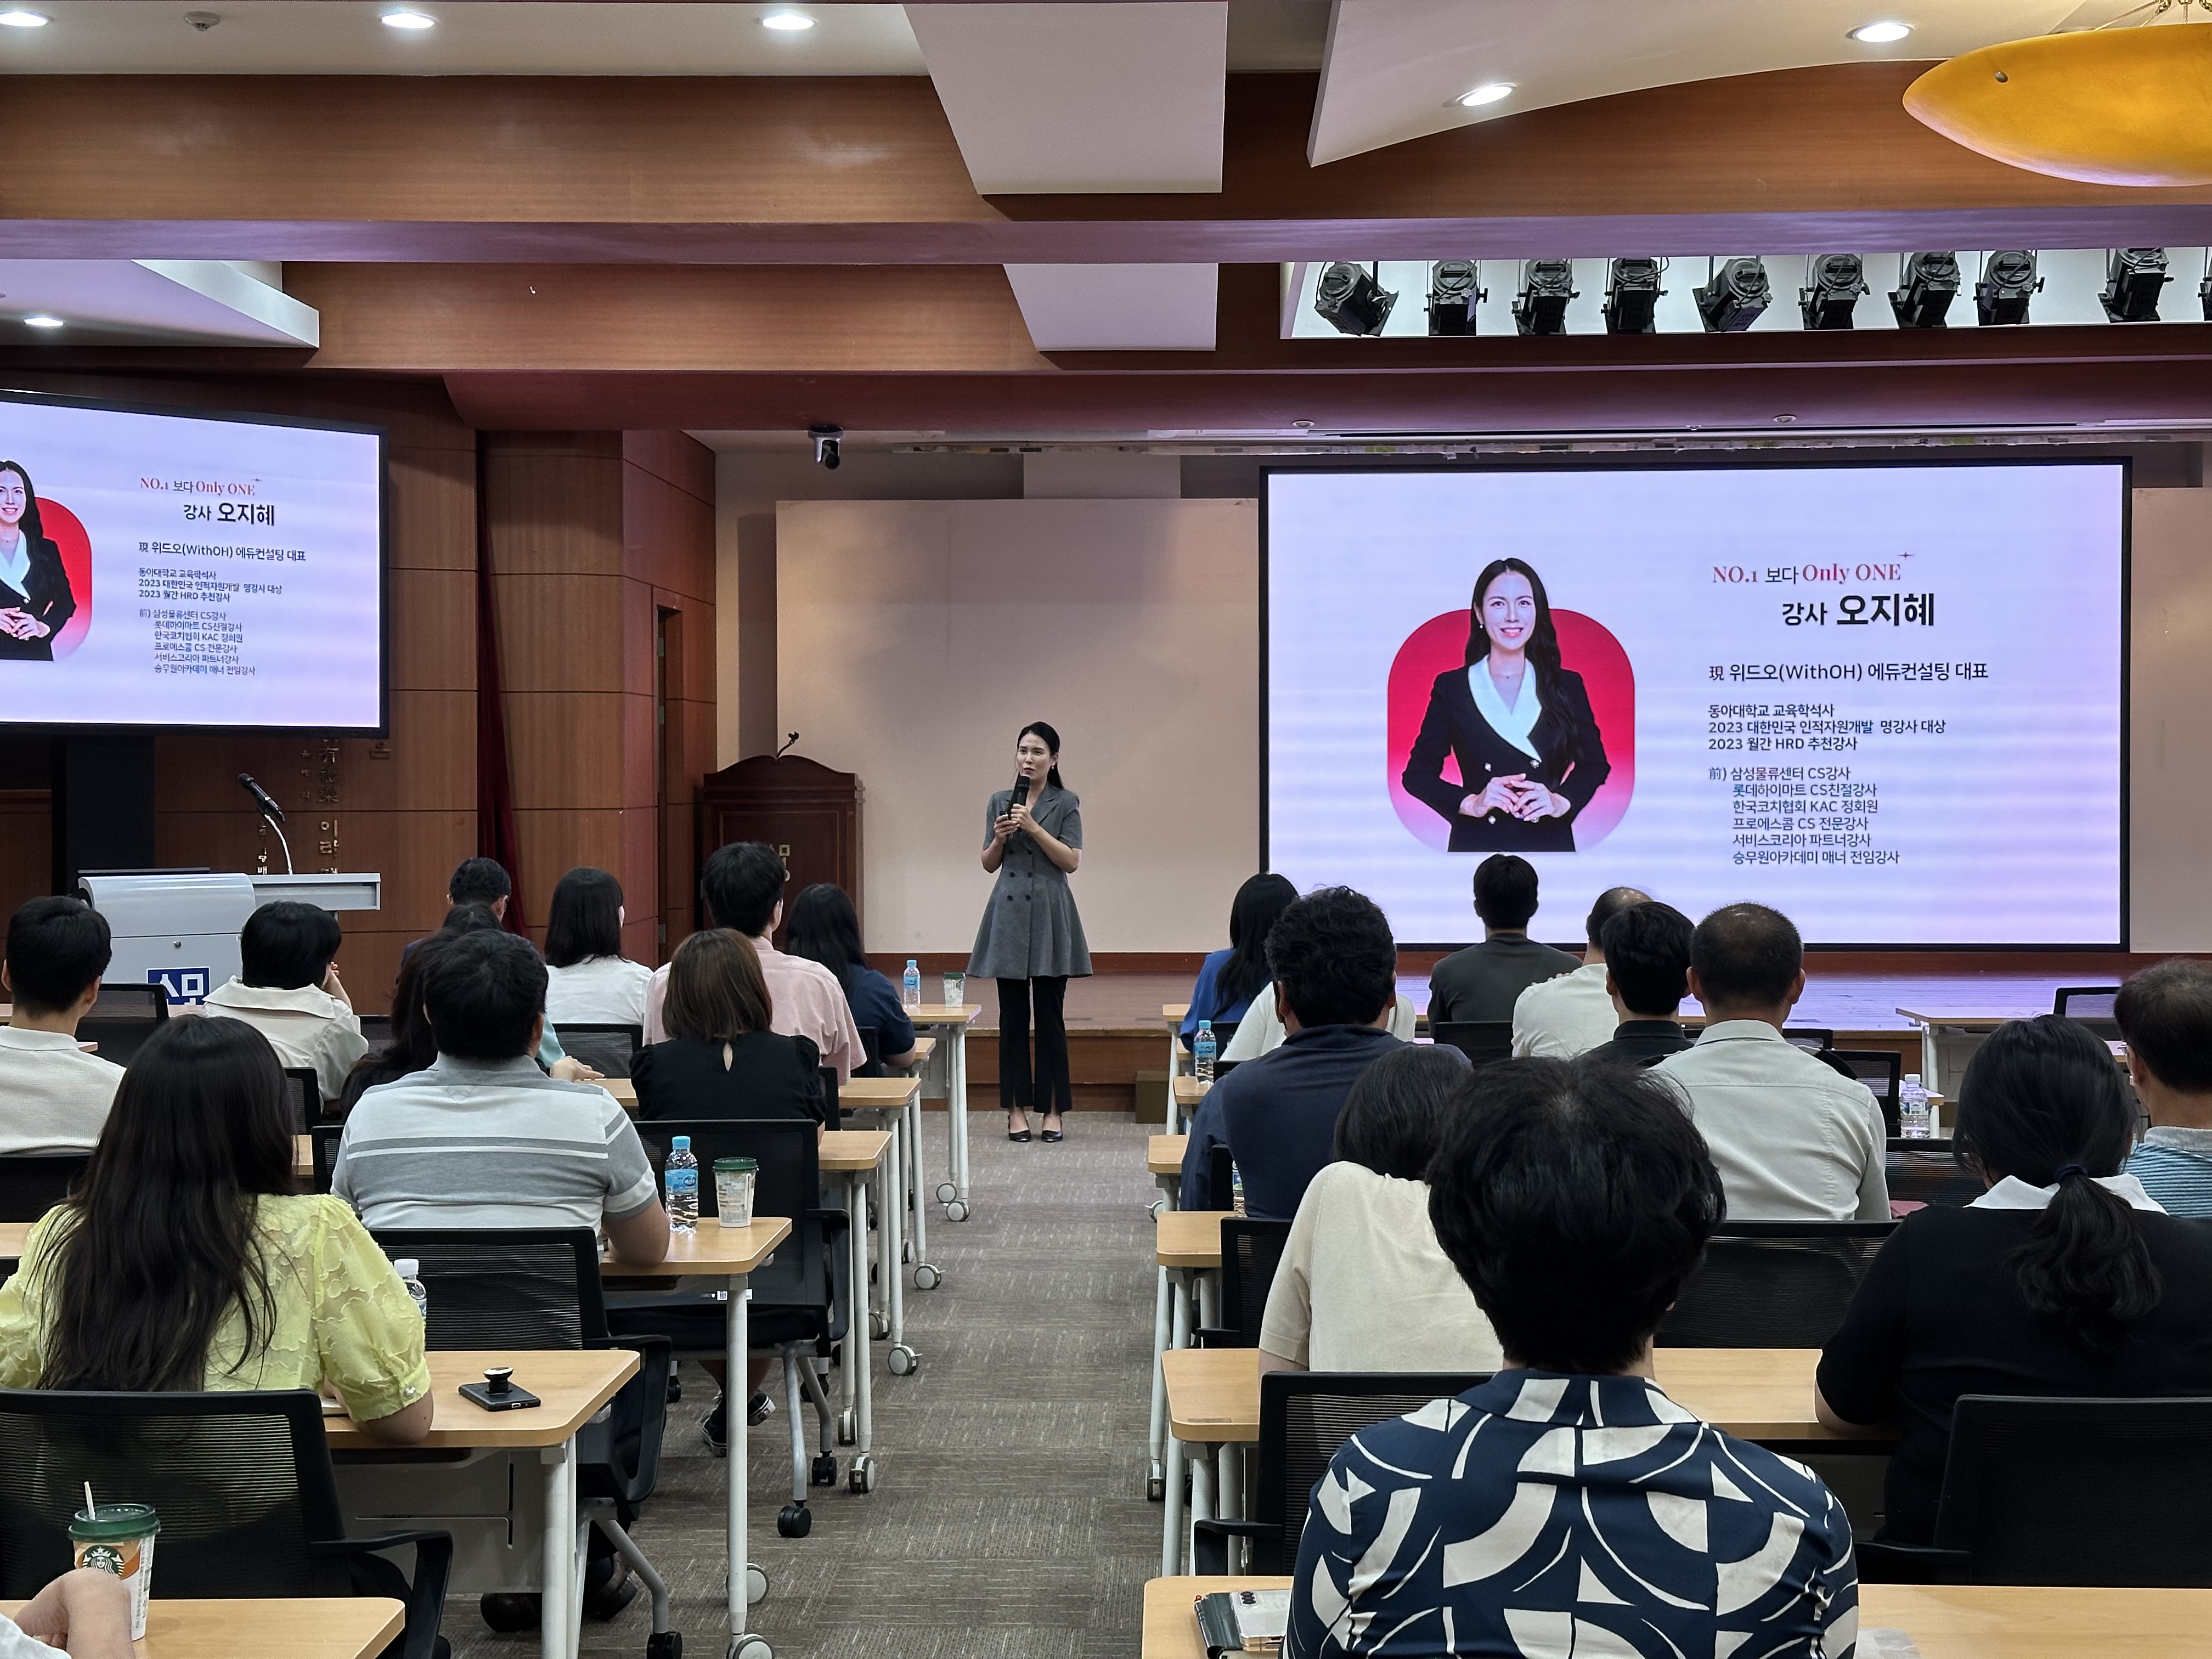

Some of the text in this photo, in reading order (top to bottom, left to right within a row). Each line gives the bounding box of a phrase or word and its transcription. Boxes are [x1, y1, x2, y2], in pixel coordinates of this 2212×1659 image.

[140, 477, 255, 496] NO.1 보다 Only ONE
[183, 502, 275, 527] 강사 오지혜
[151, 541, 233, 559] 위드오(WithOH)
[235, 546, 284, 562] 에듀컨설팅
[287, 550, 306, 562] 대표
[1713, 563, 1901, 585] NO.1 보다 Only ONE
[138, 579, 161, 588] 2023
[162, 579, 194, 590] 대한민국
[267, 585, 283, 595] 대상
[138, 589, 161, 598] 2023
[180, 591, 199, 600] HRD
[200, 611, 227, 622] CS강사
[1782, 592, 1934, 627] 강사 오지혜
[202, 633, 219, 641] KAC
[194, 643, 206, 652] CS
[207, 644, 238, 654] 전문강사
[154, 652, 240, 664] 서비스코리아 파트너강사
[1709, 662, 1989, 682] 現 위드오(WithOH) 에듀컨설팅 대표
[1707, 703, 1835, 719] 동아대학교 교육학석사
[1708, 719, 1946, 735] 2023 대한민국 인적자원개발 명강사 대상
[1708, 736, 1858, 752] 2023 월간 HRD 추천강사
[1730, 766, 1804, 781] 삼성물류센터
[1808, 766, 1851, 781] CS강사
[1733, 783, 1877, 798] 롯데하이마트 CS친절강사
[1733, 799, 1878, 814] 한국코치협회 KAC 정회원
[1733, 816, 1869, 831] 프로에스콤 CS 전문강사
[1733, 833, 1872, 848] 서비스코리아 파트너강사
[1733, 850, 1900, 865] 승무원아카데미 매너 전임강사
